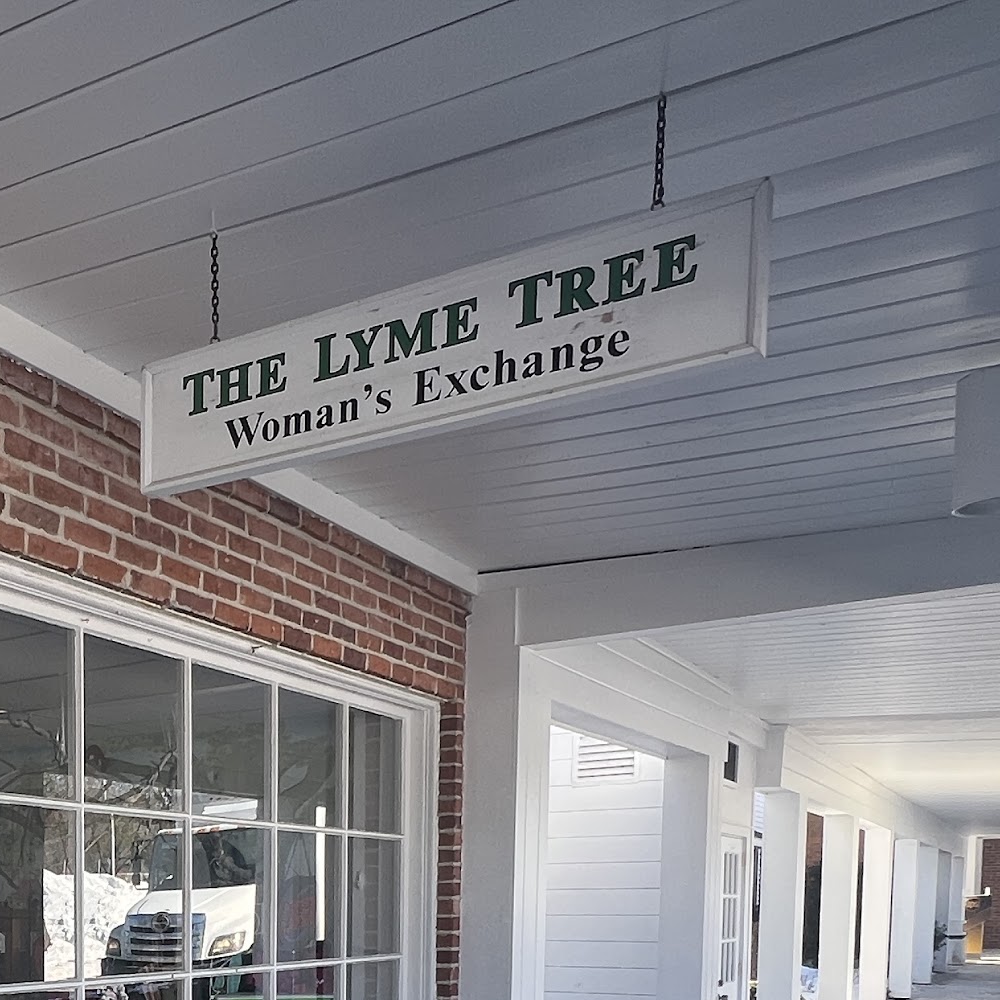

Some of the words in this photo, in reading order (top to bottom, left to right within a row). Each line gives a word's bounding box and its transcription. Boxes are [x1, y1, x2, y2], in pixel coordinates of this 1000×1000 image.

[183, 353, 287, 416] THE
[313, 297, 479, 383] LYME
[508, 233, 699, 328] TREE
[225, 384, 392, 450] Woman's
[412, 329, 631, 407] Exchange
